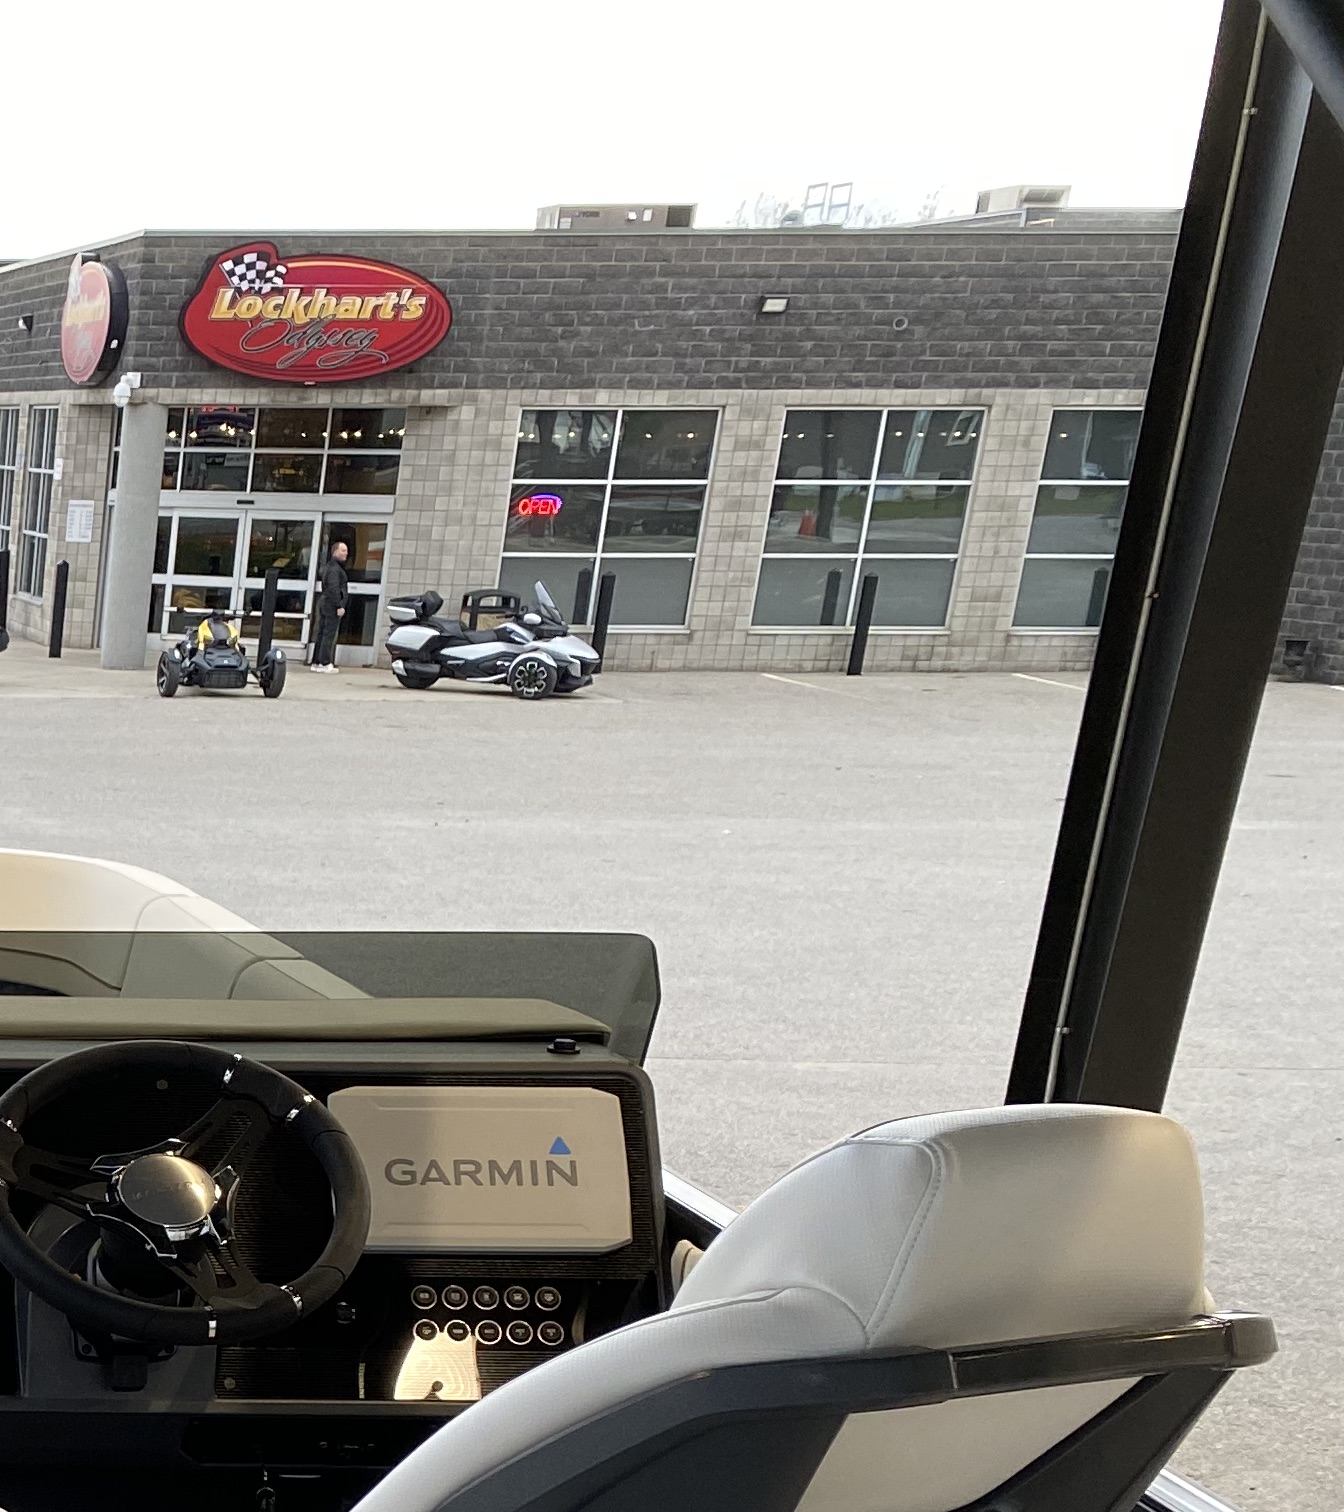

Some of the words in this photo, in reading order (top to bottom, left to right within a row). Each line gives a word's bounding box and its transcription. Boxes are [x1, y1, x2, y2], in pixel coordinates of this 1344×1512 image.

[210, 287, 427, 325] Lockhart's
[519, 498, 558, 515] OPEN
[384, 1158, 578, 1187] GARMIN
